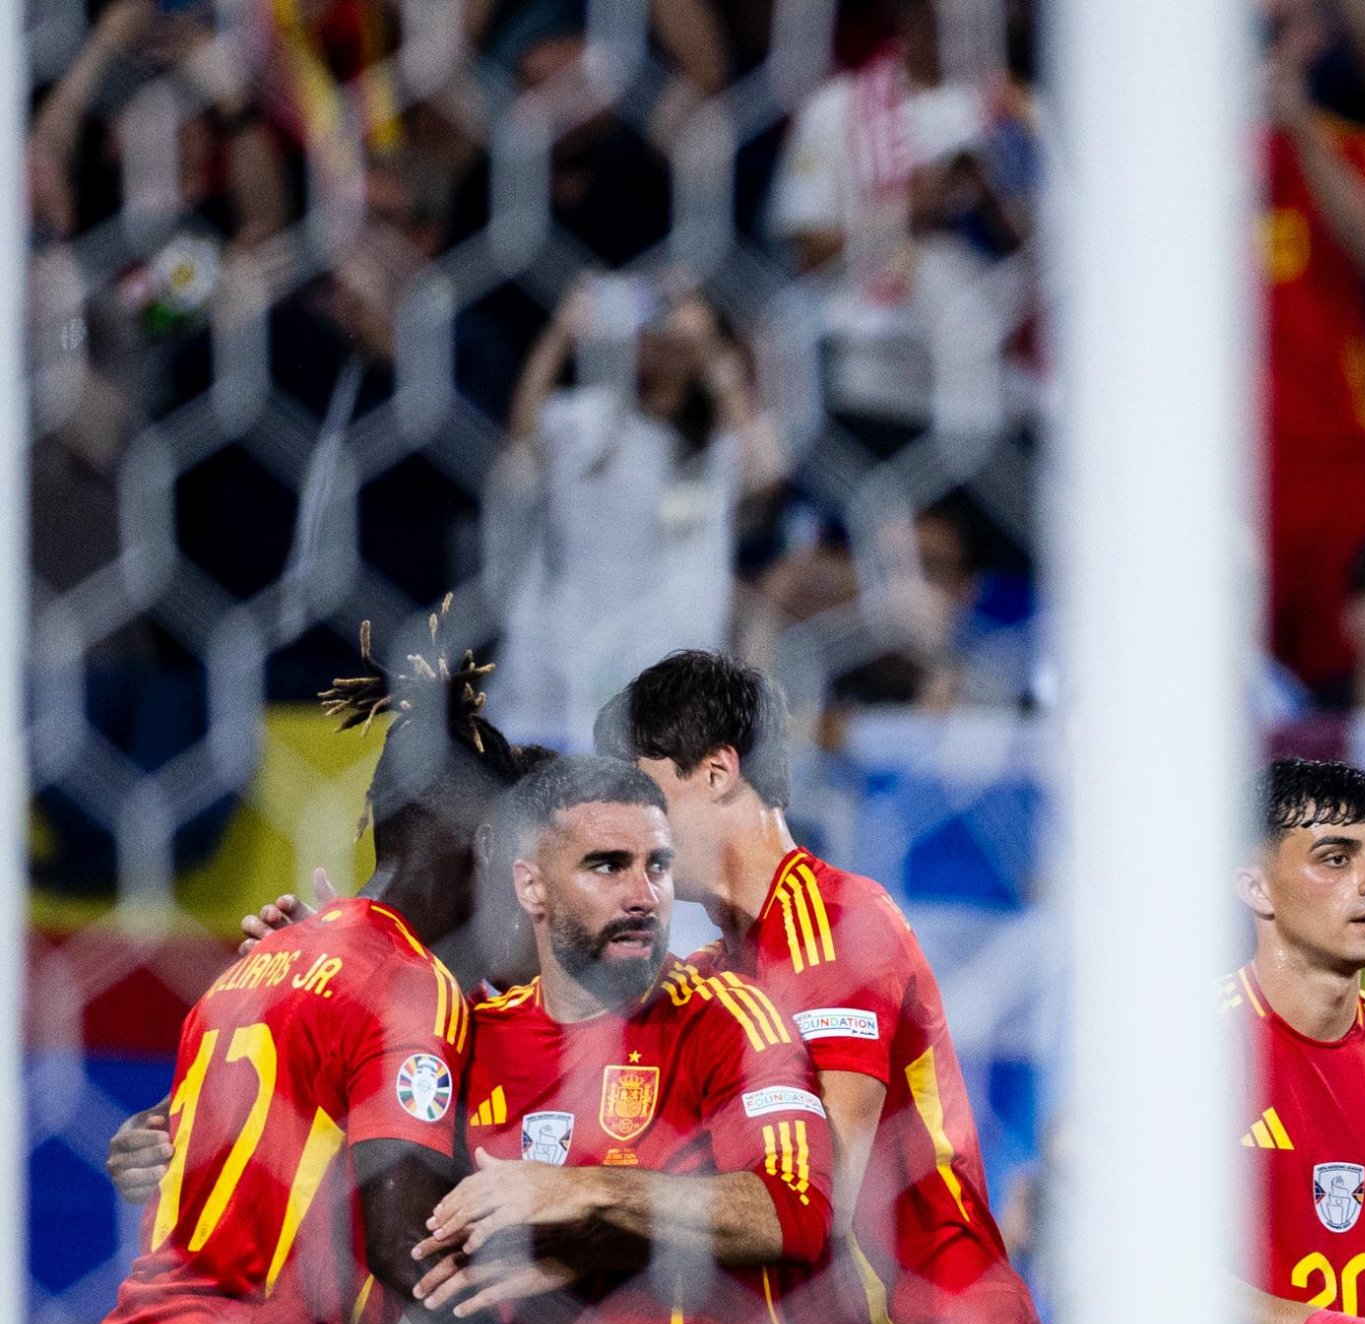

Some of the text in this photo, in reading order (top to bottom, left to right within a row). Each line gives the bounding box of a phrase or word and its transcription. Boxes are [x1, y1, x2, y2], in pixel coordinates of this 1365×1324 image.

[292, 952, 343, 998] JR.
[798, 1017, 876, 1031] OUNDATION
[151, 1023, 277, 1253] 17
